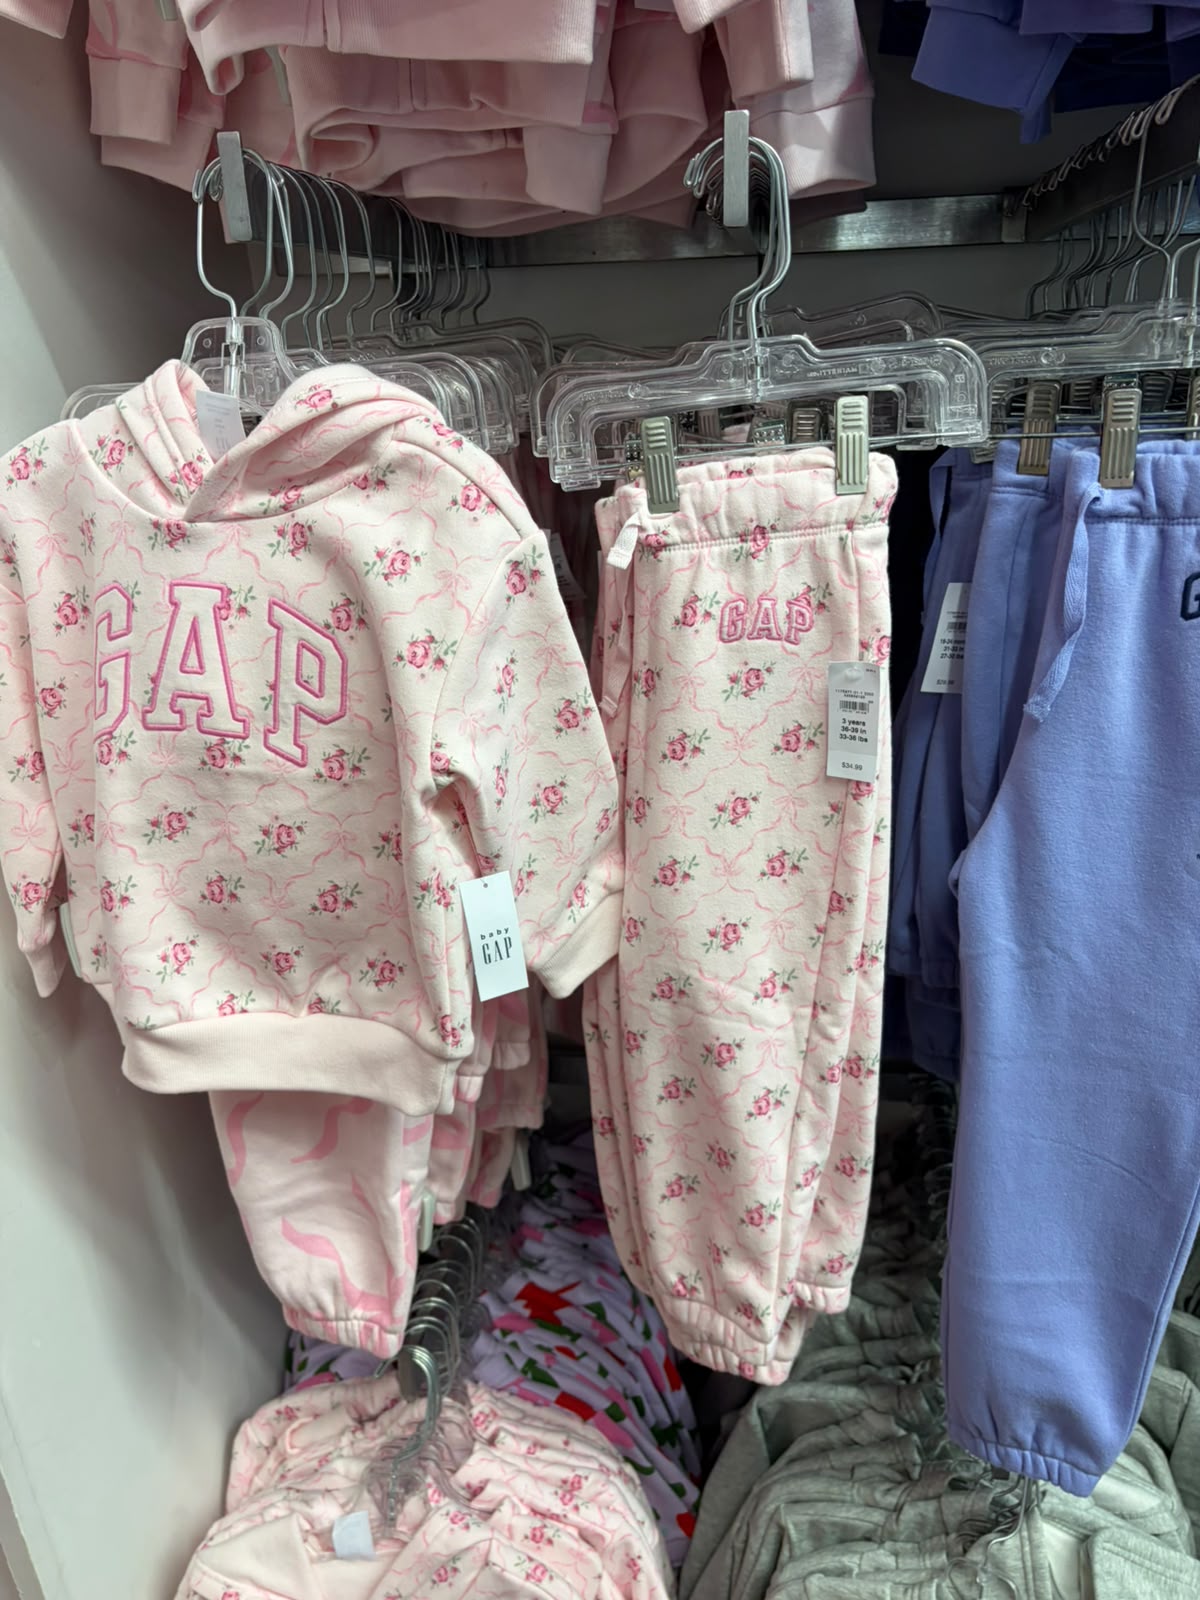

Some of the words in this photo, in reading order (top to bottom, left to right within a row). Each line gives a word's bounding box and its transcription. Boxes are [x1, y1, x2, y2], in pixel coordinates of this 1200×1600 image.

[719, 596, 815, 646] GAP
[93, 578, 348, 769] GAP
[841, 717, 847, 725] 3
[847, 719, 867, 728] years
[840, 725, 859, 734] 36-39
[860, 726, 867, 735] in
[858, 734, 868, 743] lbs
[841, 761, 863, 771] $34.99
[480, 926, 509, 941] baby
[481, 936, 513, 965] GAP
